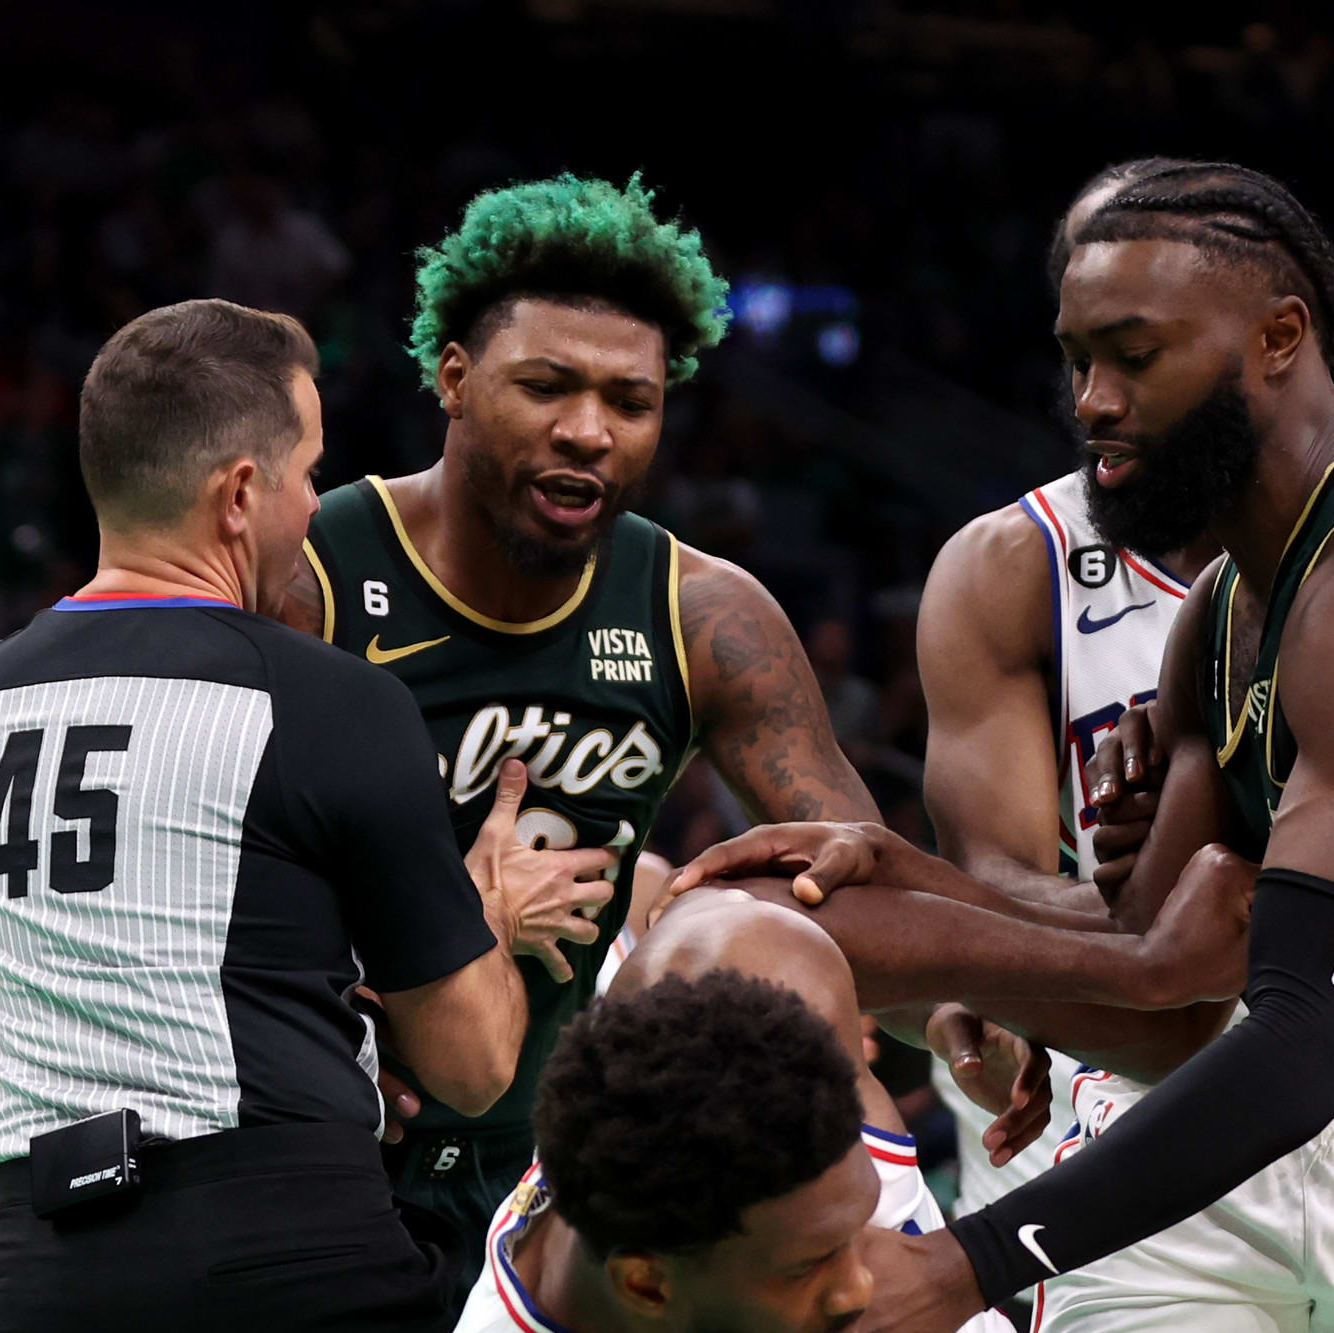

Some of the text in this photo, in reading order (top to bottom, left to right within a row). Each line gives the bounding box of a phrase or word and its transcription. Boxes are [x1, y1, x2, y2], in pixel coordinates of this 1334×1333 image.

[1080, 550, 1107, 582] 6
[363, 580, 390, 617] 6
[588, 628, 652, 660] VISTA
[590, 658, 652, 682] PRINT
[434, 1146, 460, 1171] 6
